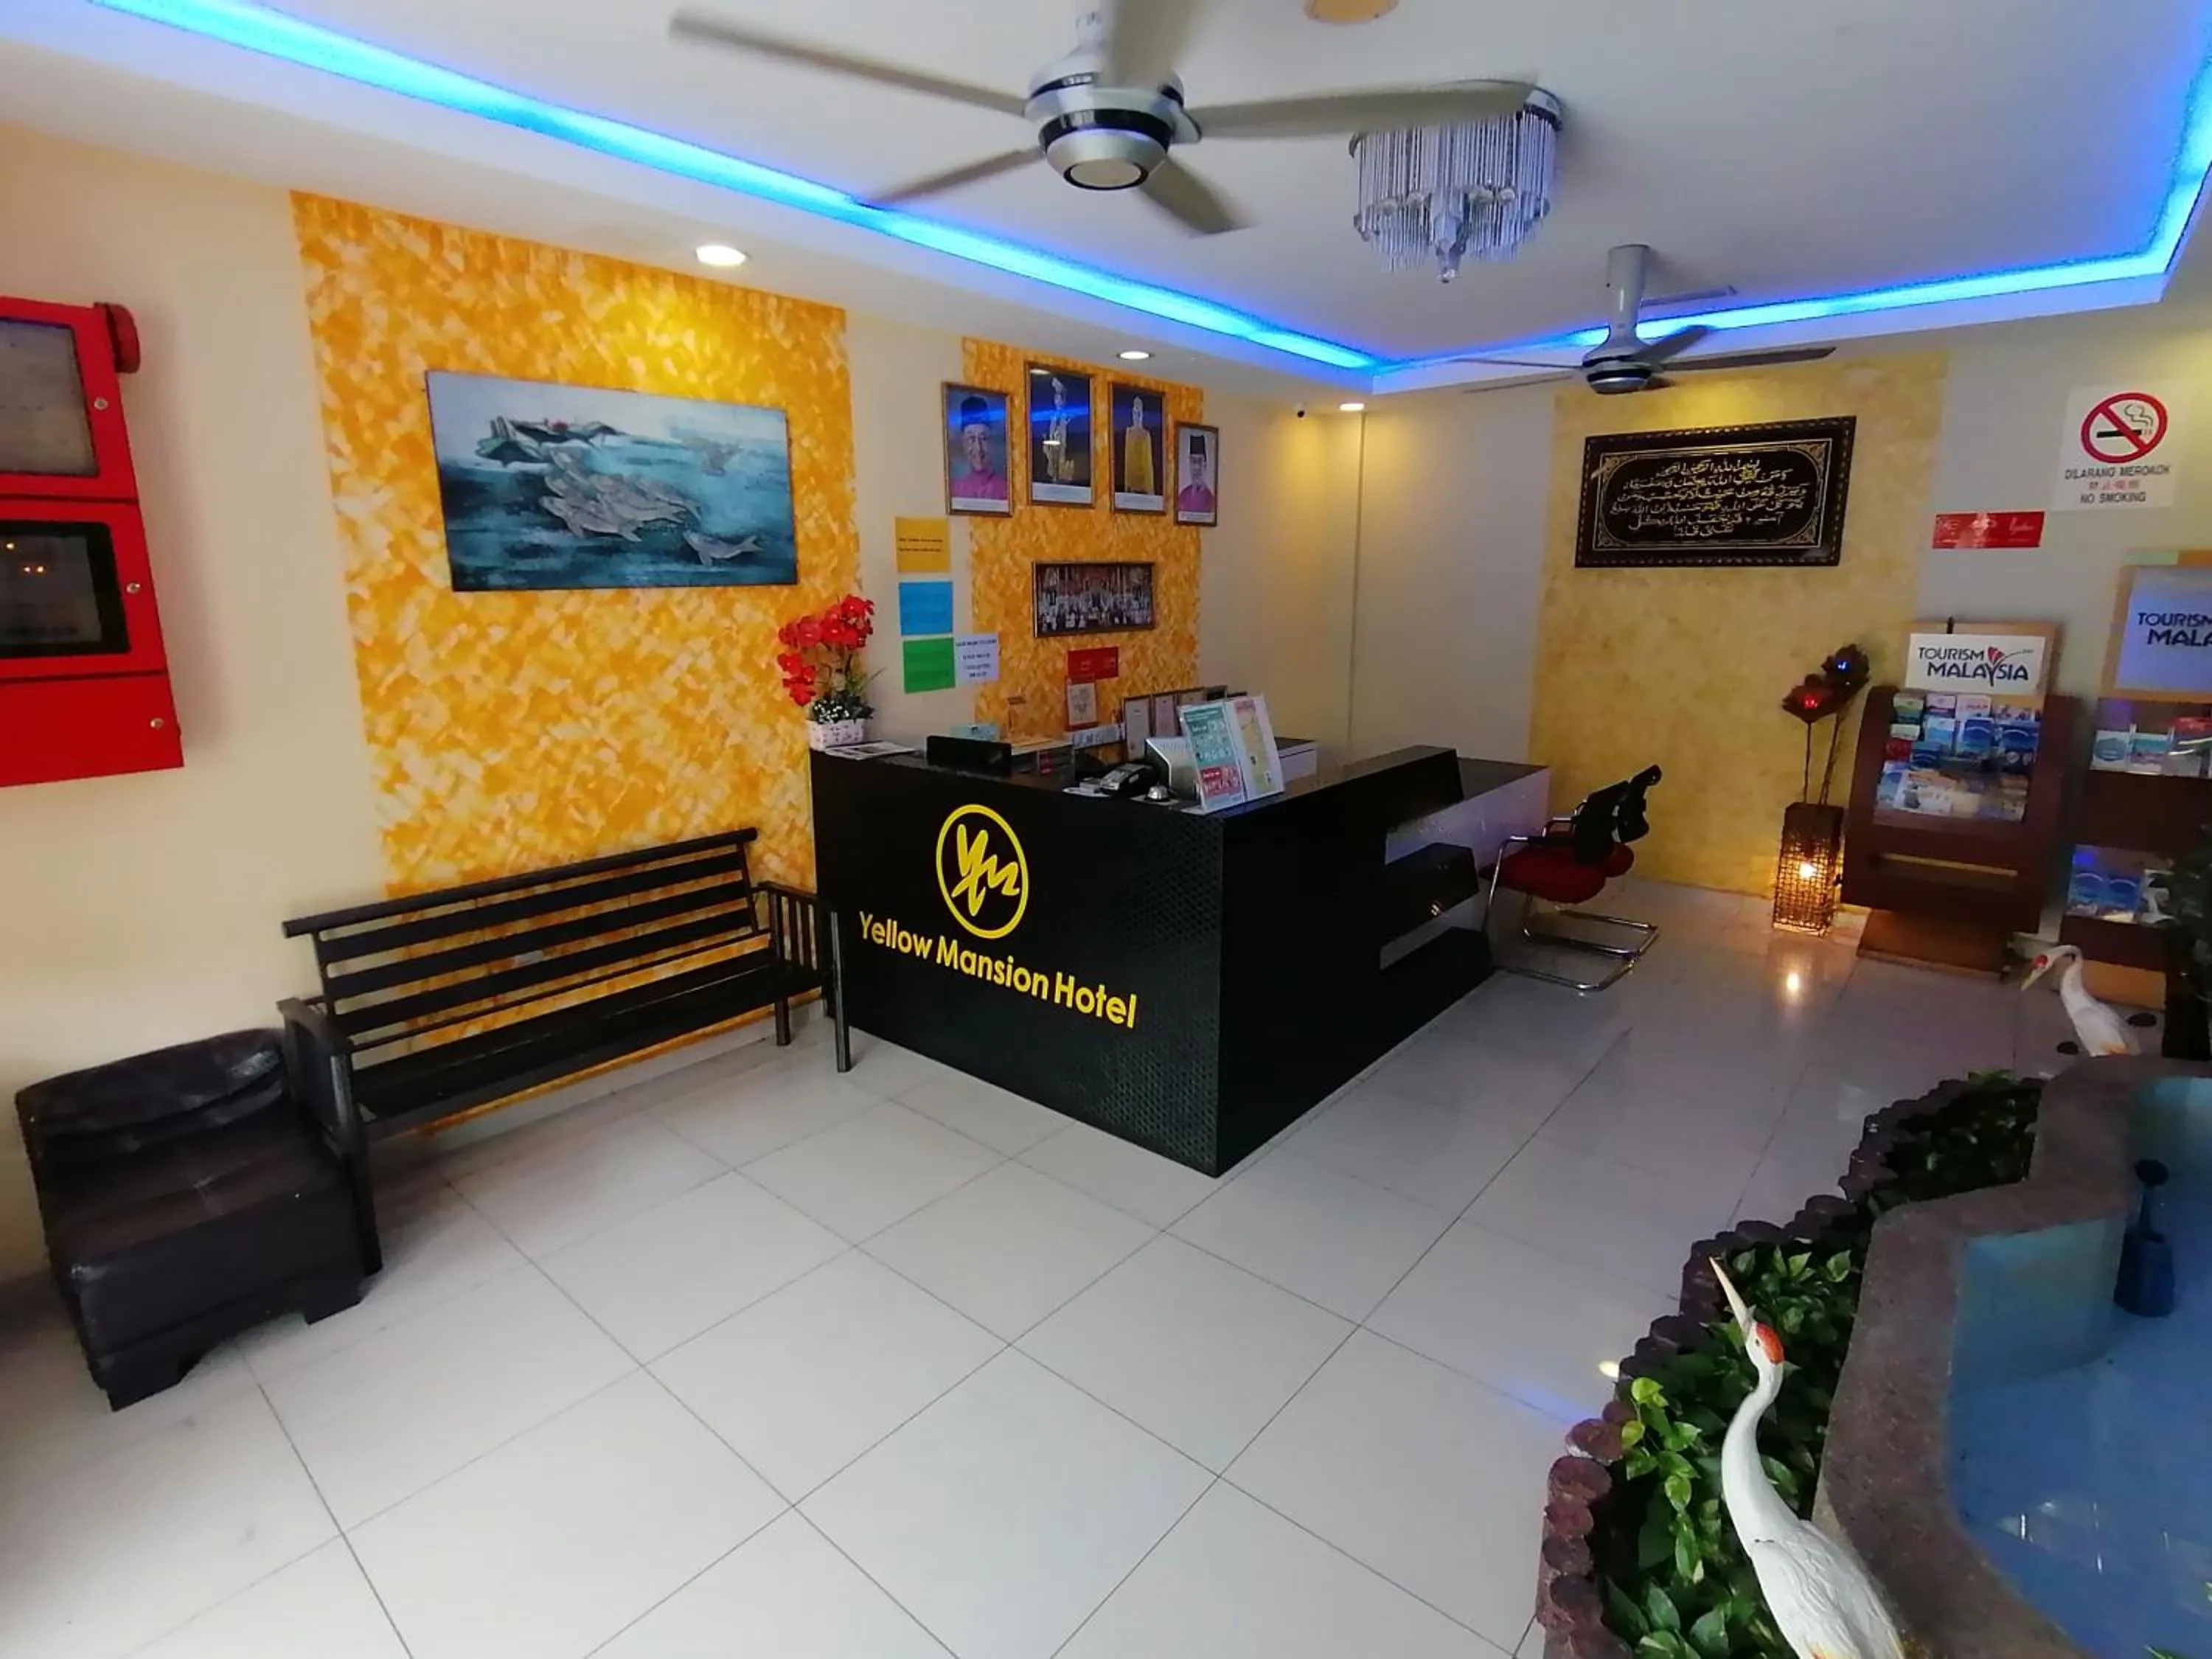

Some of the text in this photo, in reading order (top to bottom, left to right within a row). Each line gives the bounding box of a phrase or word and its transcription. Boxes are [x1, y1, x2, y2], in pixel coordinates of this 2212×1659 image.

[2080, 492, 2146, 504] NO SMOKING
[1918, 647, 1984, 661] TOURISM
[1927, 661, 2029, 687] MALAYSIA
[859, 911, 1137, 1029] Yellow Mansion Hotel
